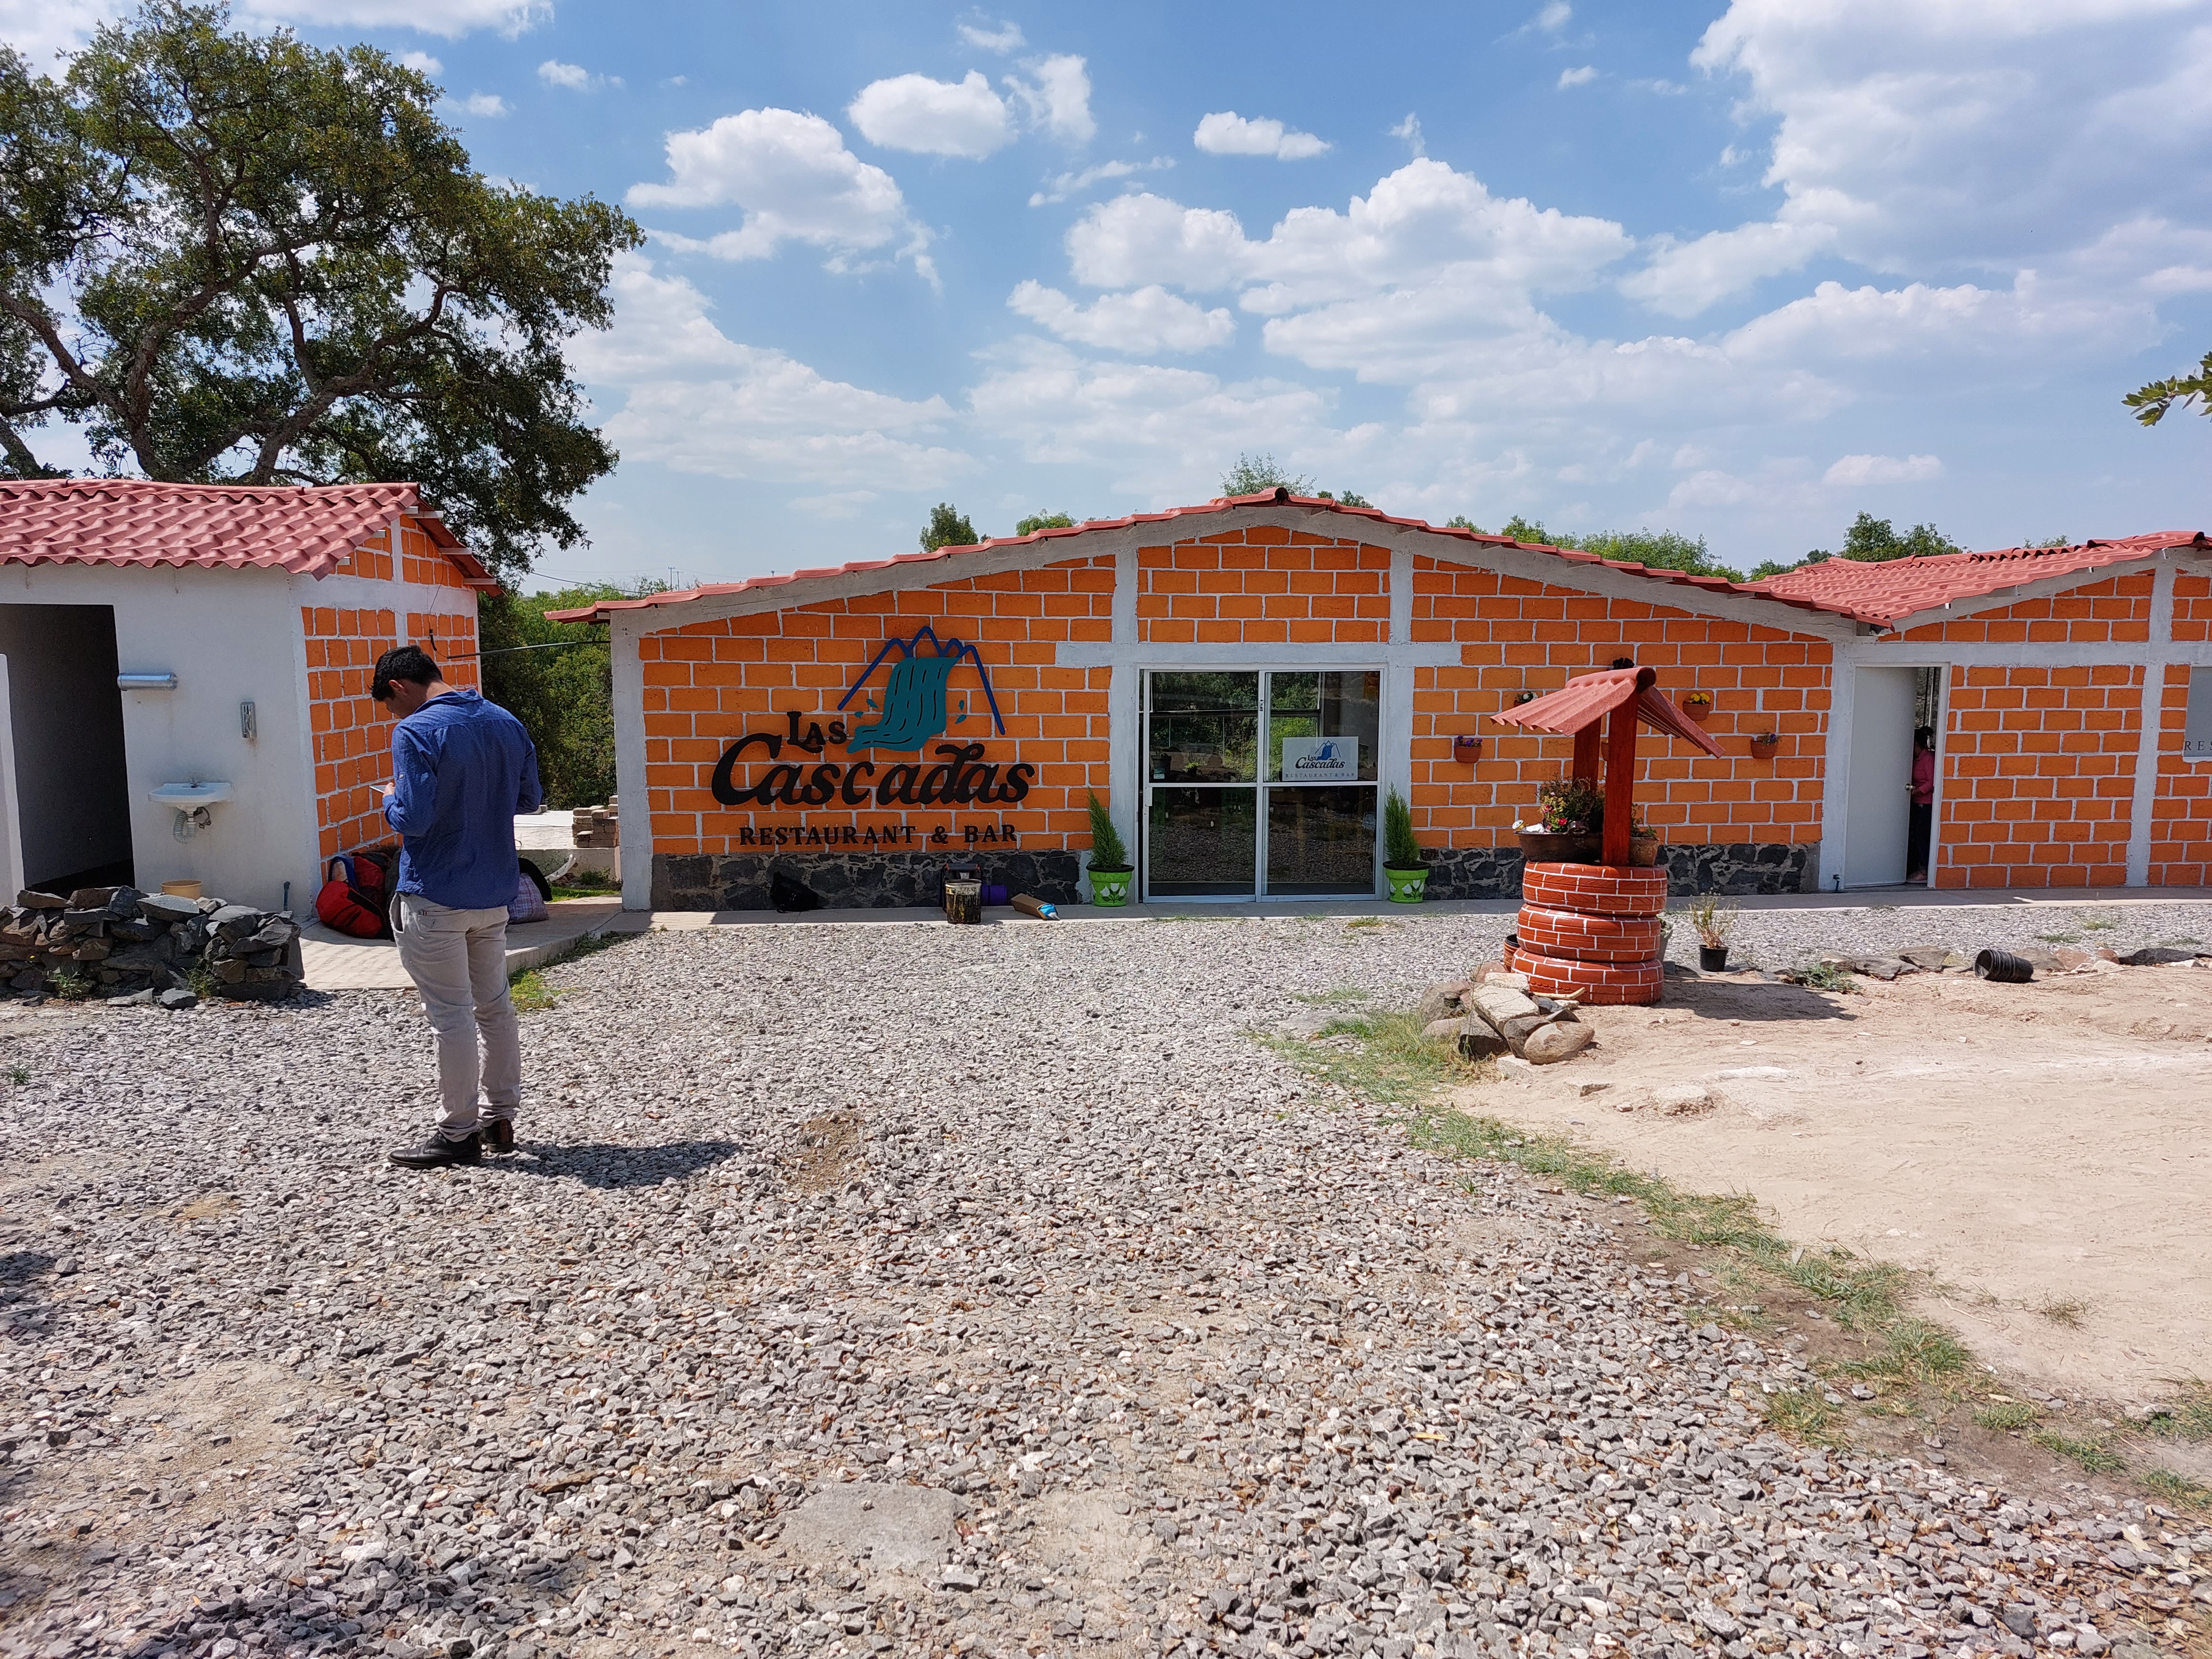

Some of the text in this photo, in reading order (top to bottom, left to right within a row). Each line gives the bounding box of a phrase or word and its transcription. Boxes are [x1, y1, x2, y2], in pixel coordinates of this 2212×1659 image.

[711, 733, 1035, 806] Cascadas
[1295, 757, 1345, 769] Cascadas
[739, 824, 1017, 846] RESTAURANT & BAR
